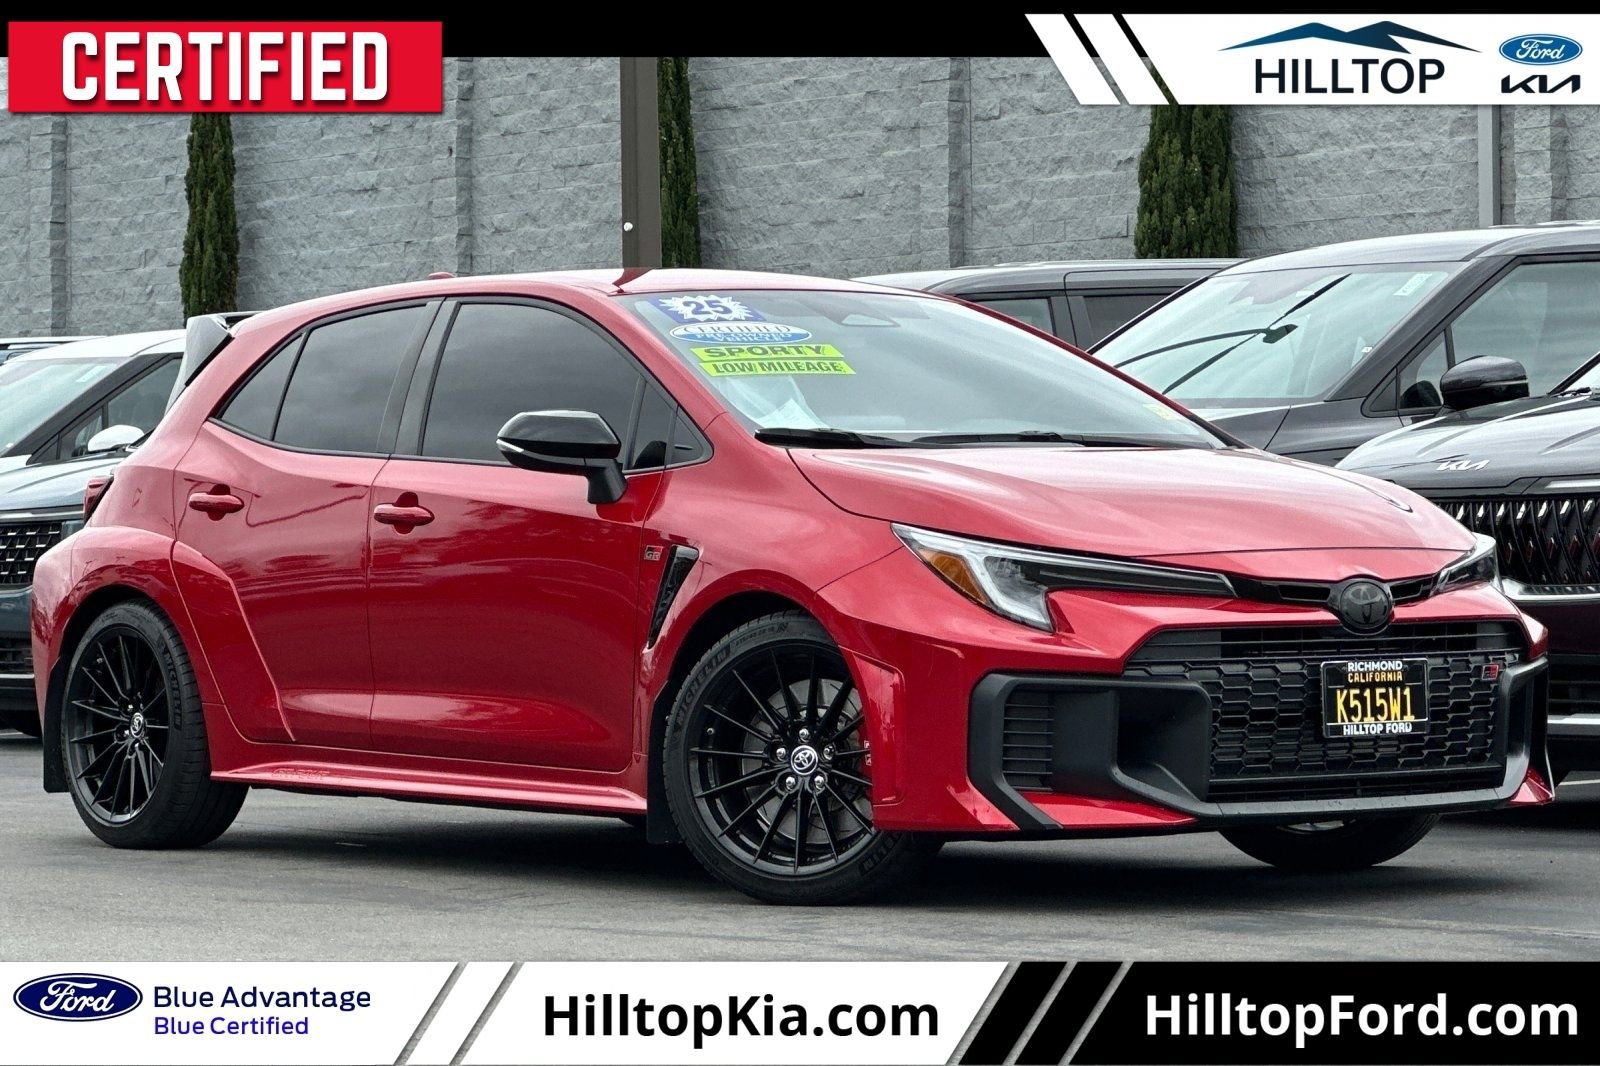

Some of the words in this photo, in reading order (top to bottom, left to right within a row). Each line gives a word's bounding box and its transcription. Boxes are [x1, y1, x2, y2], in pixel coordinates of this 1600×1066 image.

[682, 299, 733, 315] 25
[683, 325, 791, 333] CERTIFIED
[703, 345, 825, 358] SPORTY
[712, 362, 754, 374] LOW
[760, 361, 844, 373] MILEAGE
[1436, 459, 1490, 471] KIA
[1347, 660, 1403, 671] RICHMOND
[1347, 671, 1403, 683] CALIFORNIA
[163, 652, 182, 727] MICHELIN
[676, 649, 727, 725] MICHELIN
[1336, 686, 1415, 723] K515W1
[1343, 723, 1383, 736] HILLTOP
[1385, 721, 1413, 734] FORD
